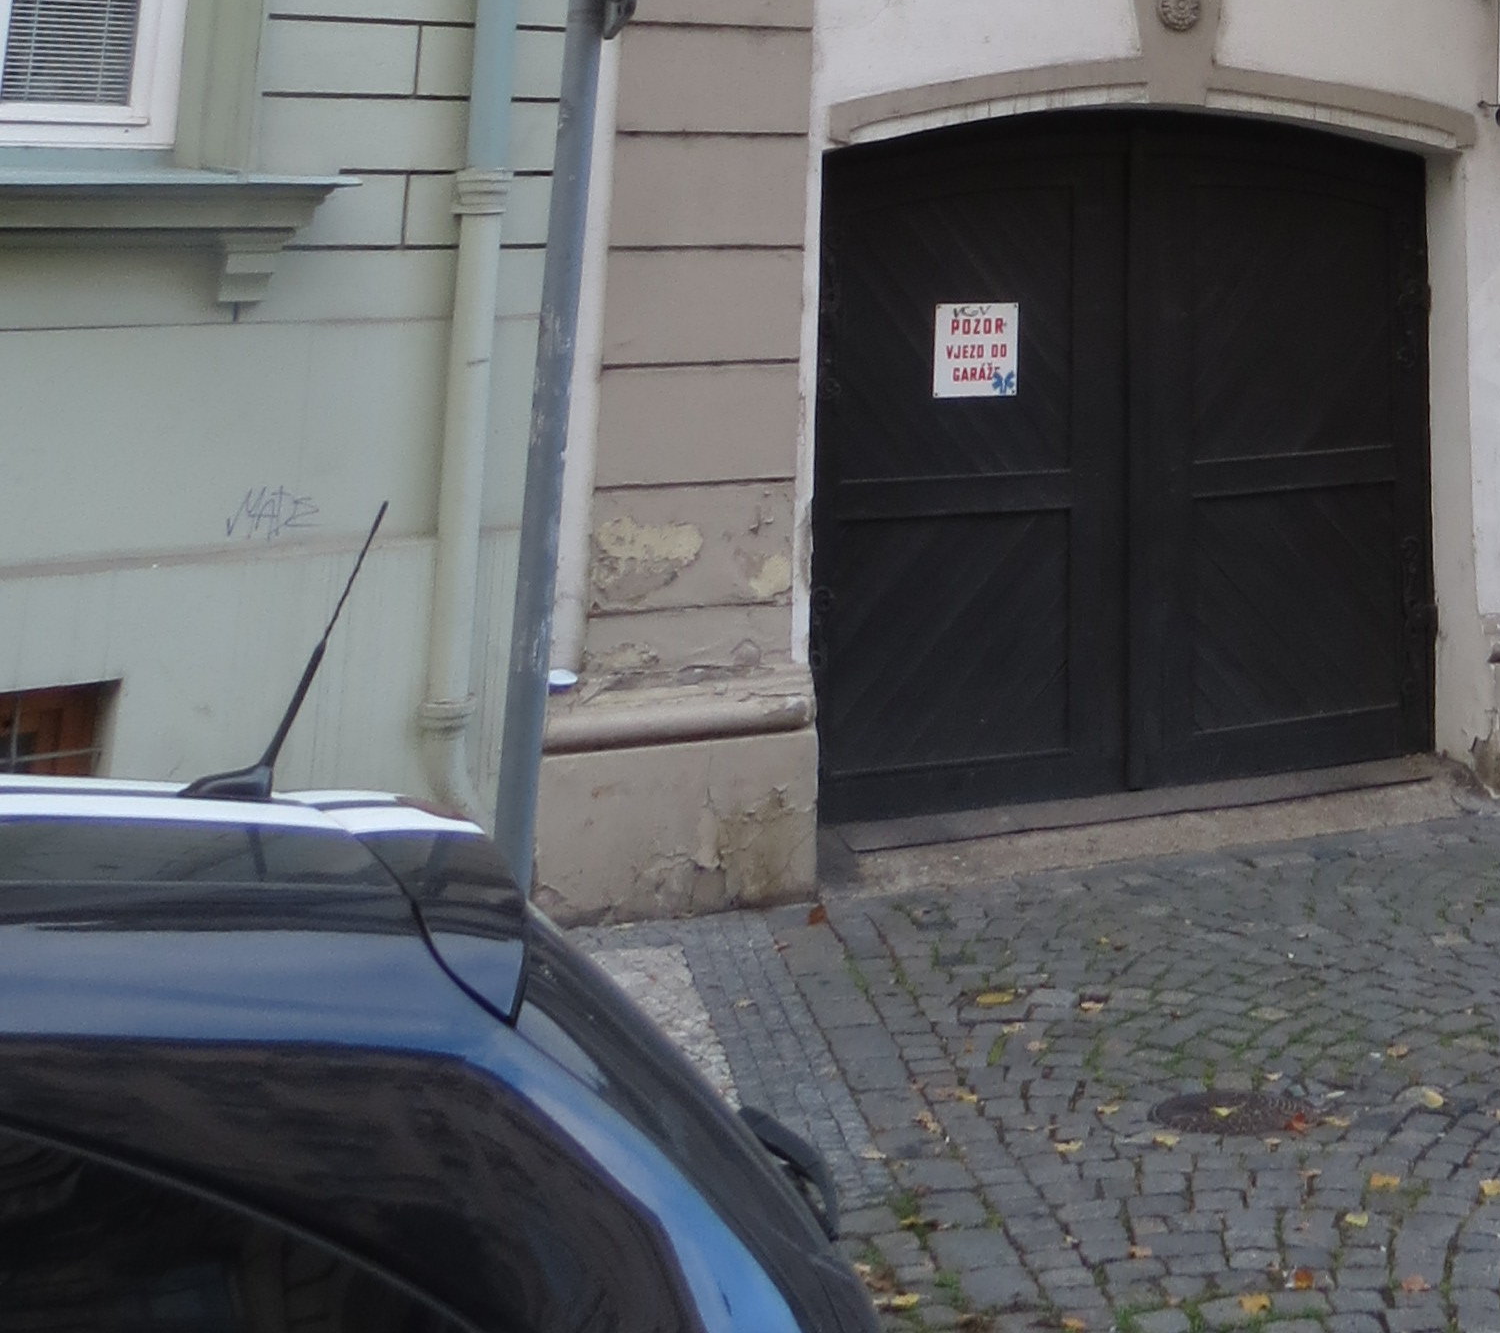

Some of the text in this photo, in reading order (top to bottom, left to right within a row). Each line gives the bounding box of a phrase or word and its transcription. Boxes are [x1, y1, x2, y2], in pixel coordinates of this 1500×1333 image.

[951, 318, 1004, 335] POZOR
[946, 344, 1007, 359] VJEZD DO
